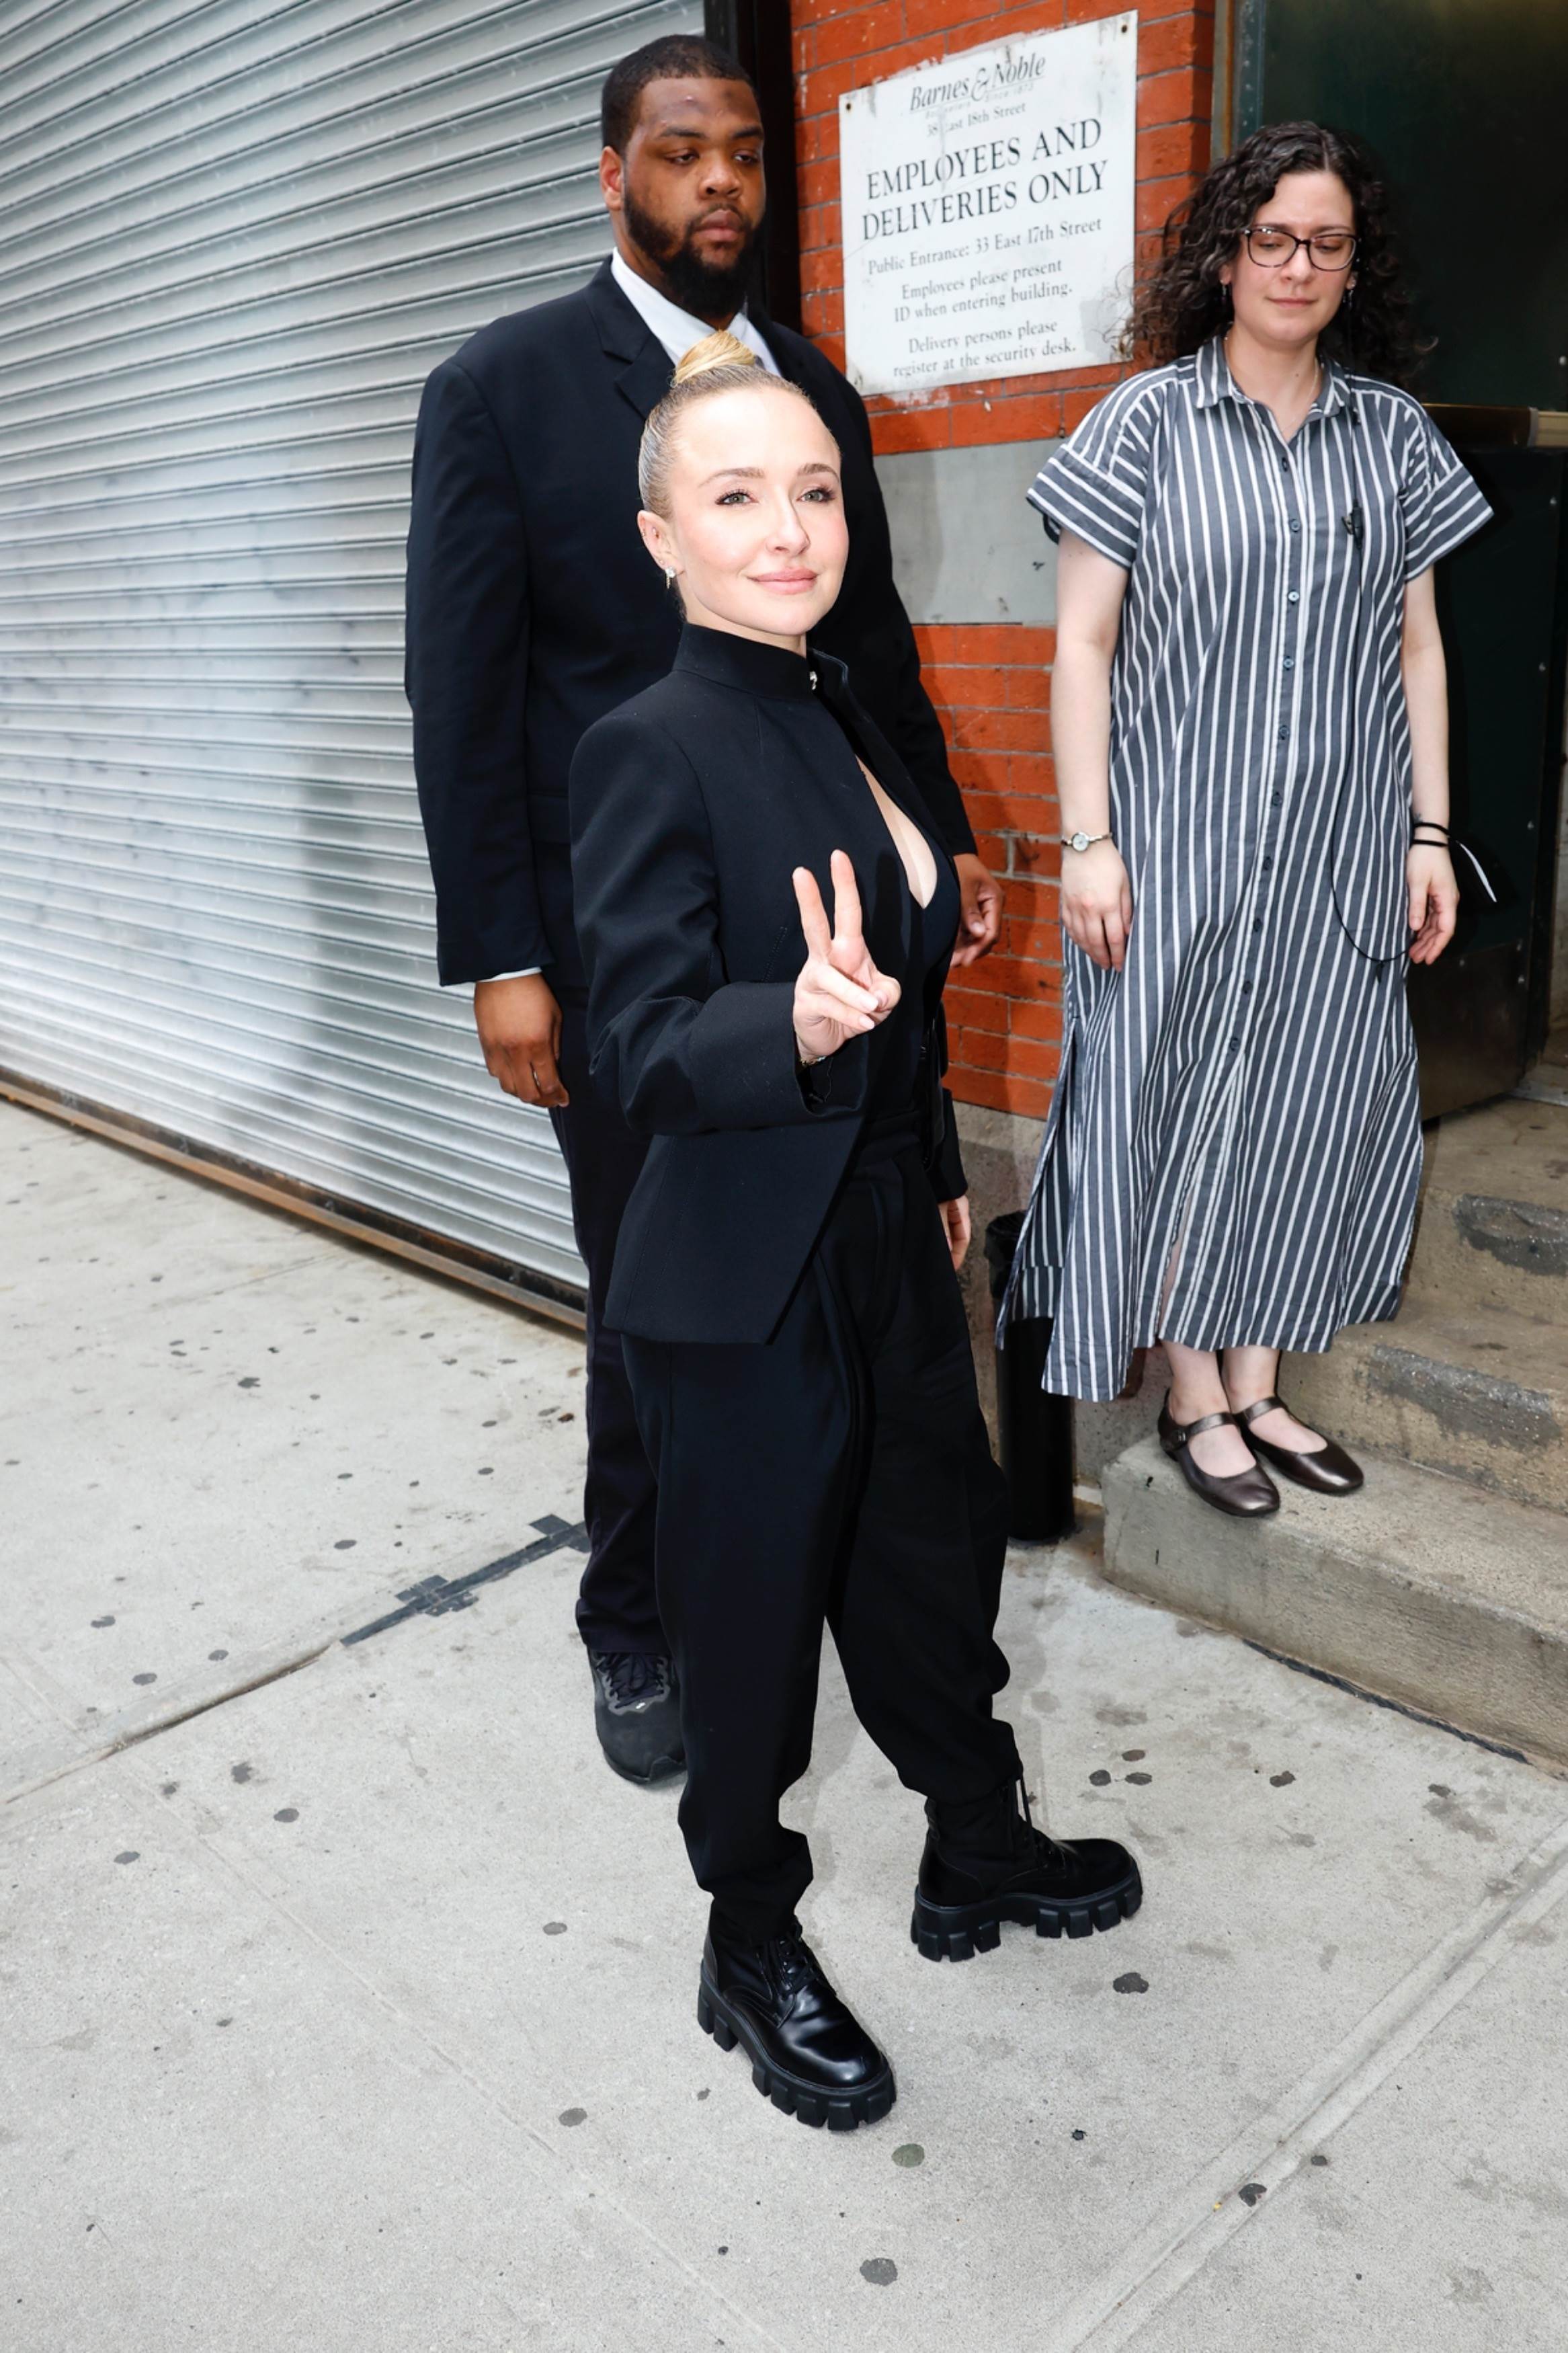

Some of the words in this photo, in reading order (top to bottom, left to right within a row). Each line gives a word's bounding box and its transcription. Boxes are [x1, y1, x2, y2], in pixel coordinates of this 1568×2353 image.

[910, 78, 970, 111] Barnes
[971, 68, 990, 102] &
[992, 52, 1046, 88] Noble
[968, 109, 990, 126] 18th
[993, 102, 1026, 119] Street
[867, 137, 1021, 200] EMPLOYEES
[1032, 118, 1102, 161] AND
[862, 181, 1018, 241] DELIVERIES
[1029, 159, 1108, 204] ONLY
[868, 255, 905, 275] Public
[910, 245, 970, 267] Entrance:
[975, 236, 989, 254] 33
[995, 233, 1021, 250] East
[1028, 224, 1054, 244] 17th
[1060, 218, 1102, 238] Street
[902, 278, 965, 300] Employees
[970, 270, 1008, 290] please
[1014, 260, 1062, 283] present
[895, 306, 911, 323] ID
[915, 302, 947, 317] when
[952, 293, 1006, 313] entering
[1011, 281, 1073, 303] building.
[893, 360, 938, 378] register
[943, 358, 955, 370] at
[959, 352, 981, 367] the
[985, 345, 1037, 364] security
[1042, 337, 1077, 356] desk.
[909, 335, 960, 353] Delivery
[965, 329, 1013, 348] persons
[1018, 320, 1058, 340] please
